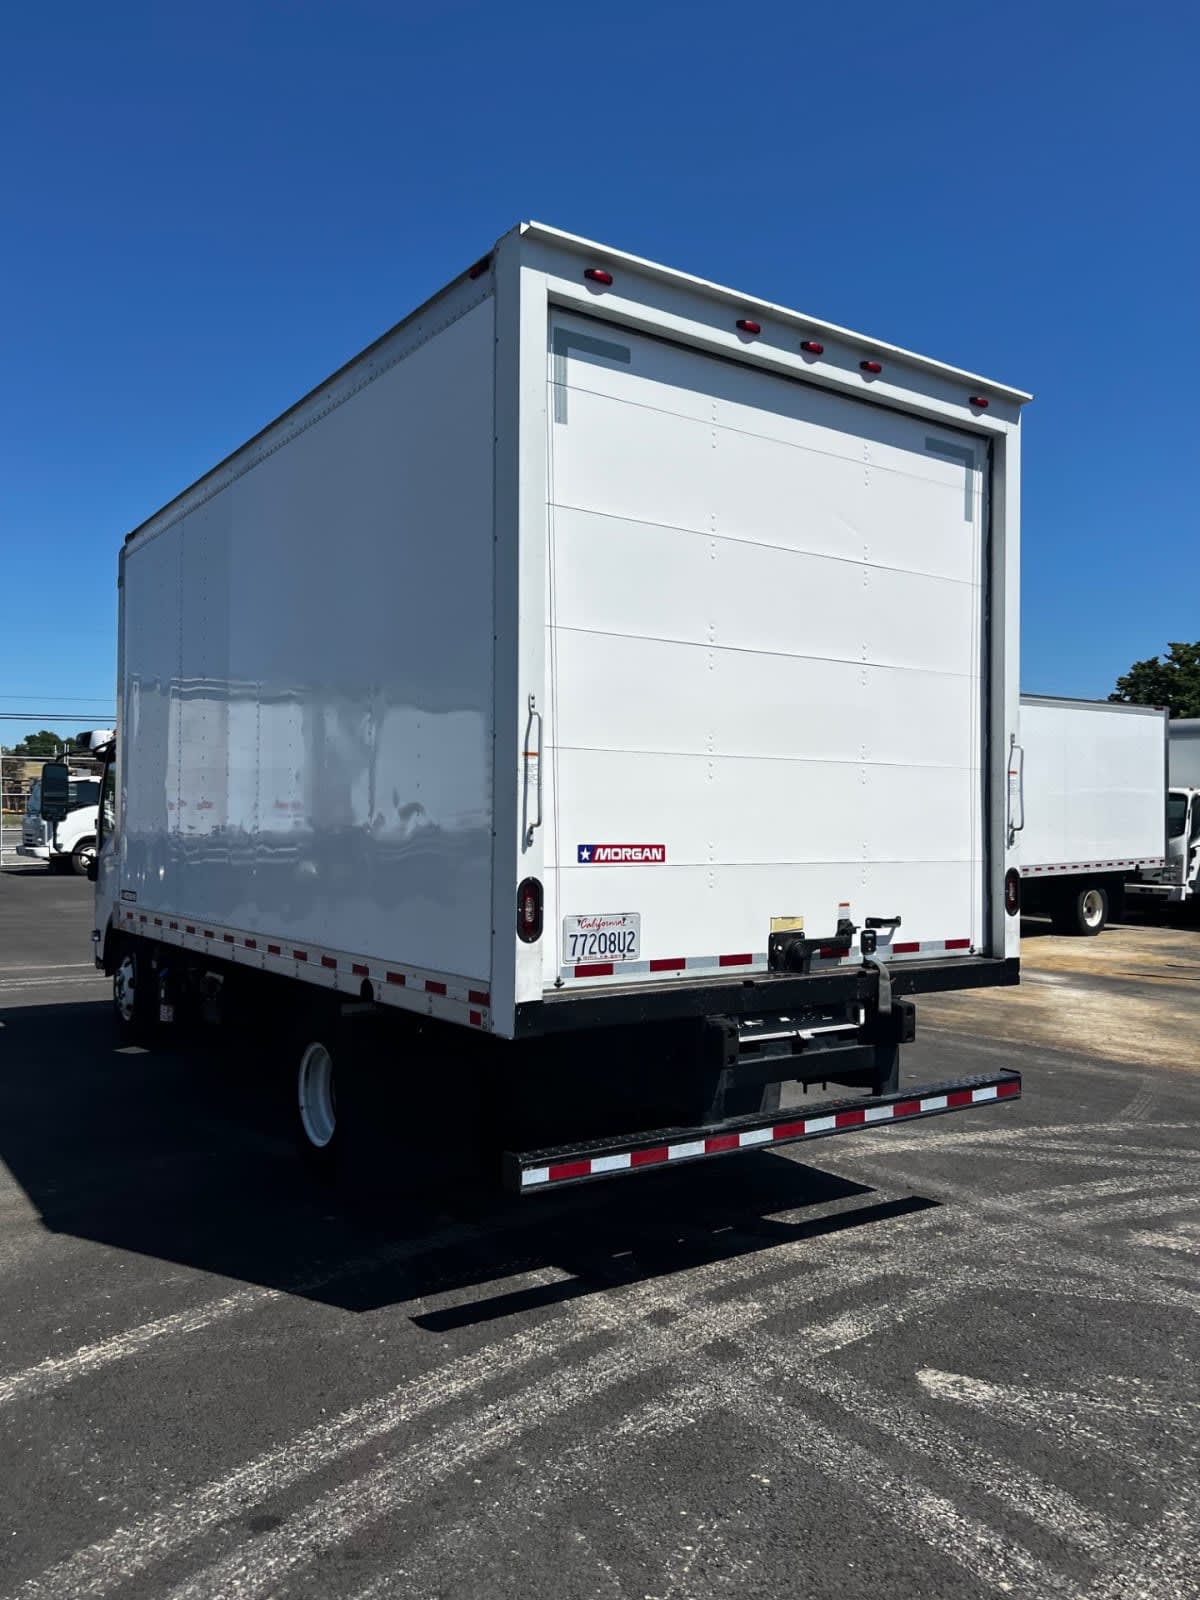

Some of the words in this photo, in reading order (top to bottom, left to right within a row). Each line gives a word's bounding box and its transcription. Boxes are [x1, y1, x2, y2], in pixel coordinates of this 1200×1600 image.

[595, 847, 662, 861] MORGAN
[580, 917, 625, 931] California
[569, 931, 635, 956] 77208U2
